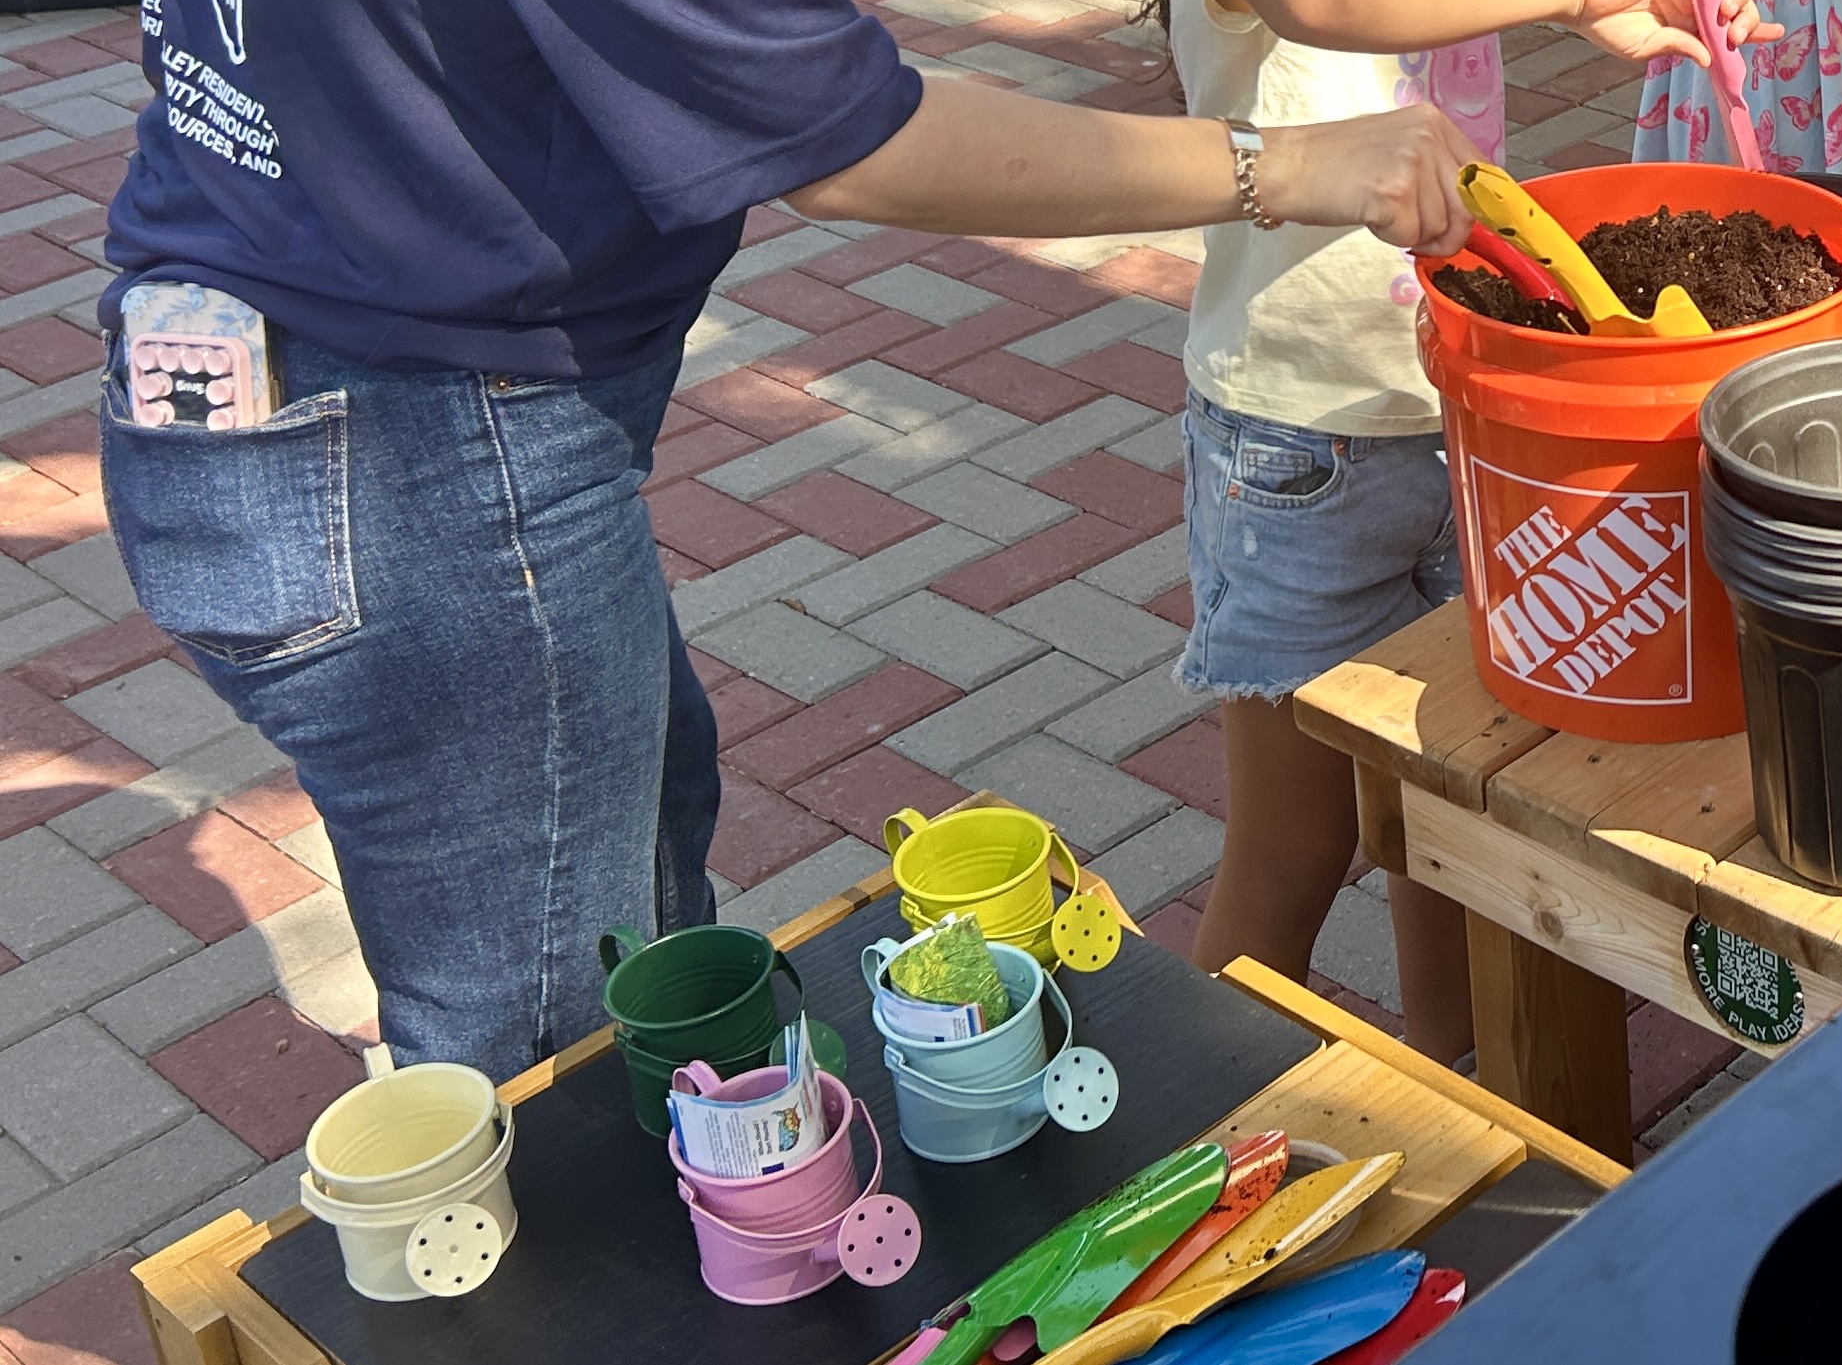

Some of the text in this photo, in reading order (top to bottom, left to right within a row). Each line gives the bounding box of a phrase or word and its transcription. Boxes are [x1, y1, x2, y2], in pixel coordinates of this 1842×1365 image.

[168, 102, 283, 180] OURCES, AND
[1493, 505, 1573, 579] THE
[1490, 494, 1688, 677] HOME
[1552, 571, 1688, 696] DEPOT
[1694, 957, 1806, 1041] MORE PLAY IDEAS
